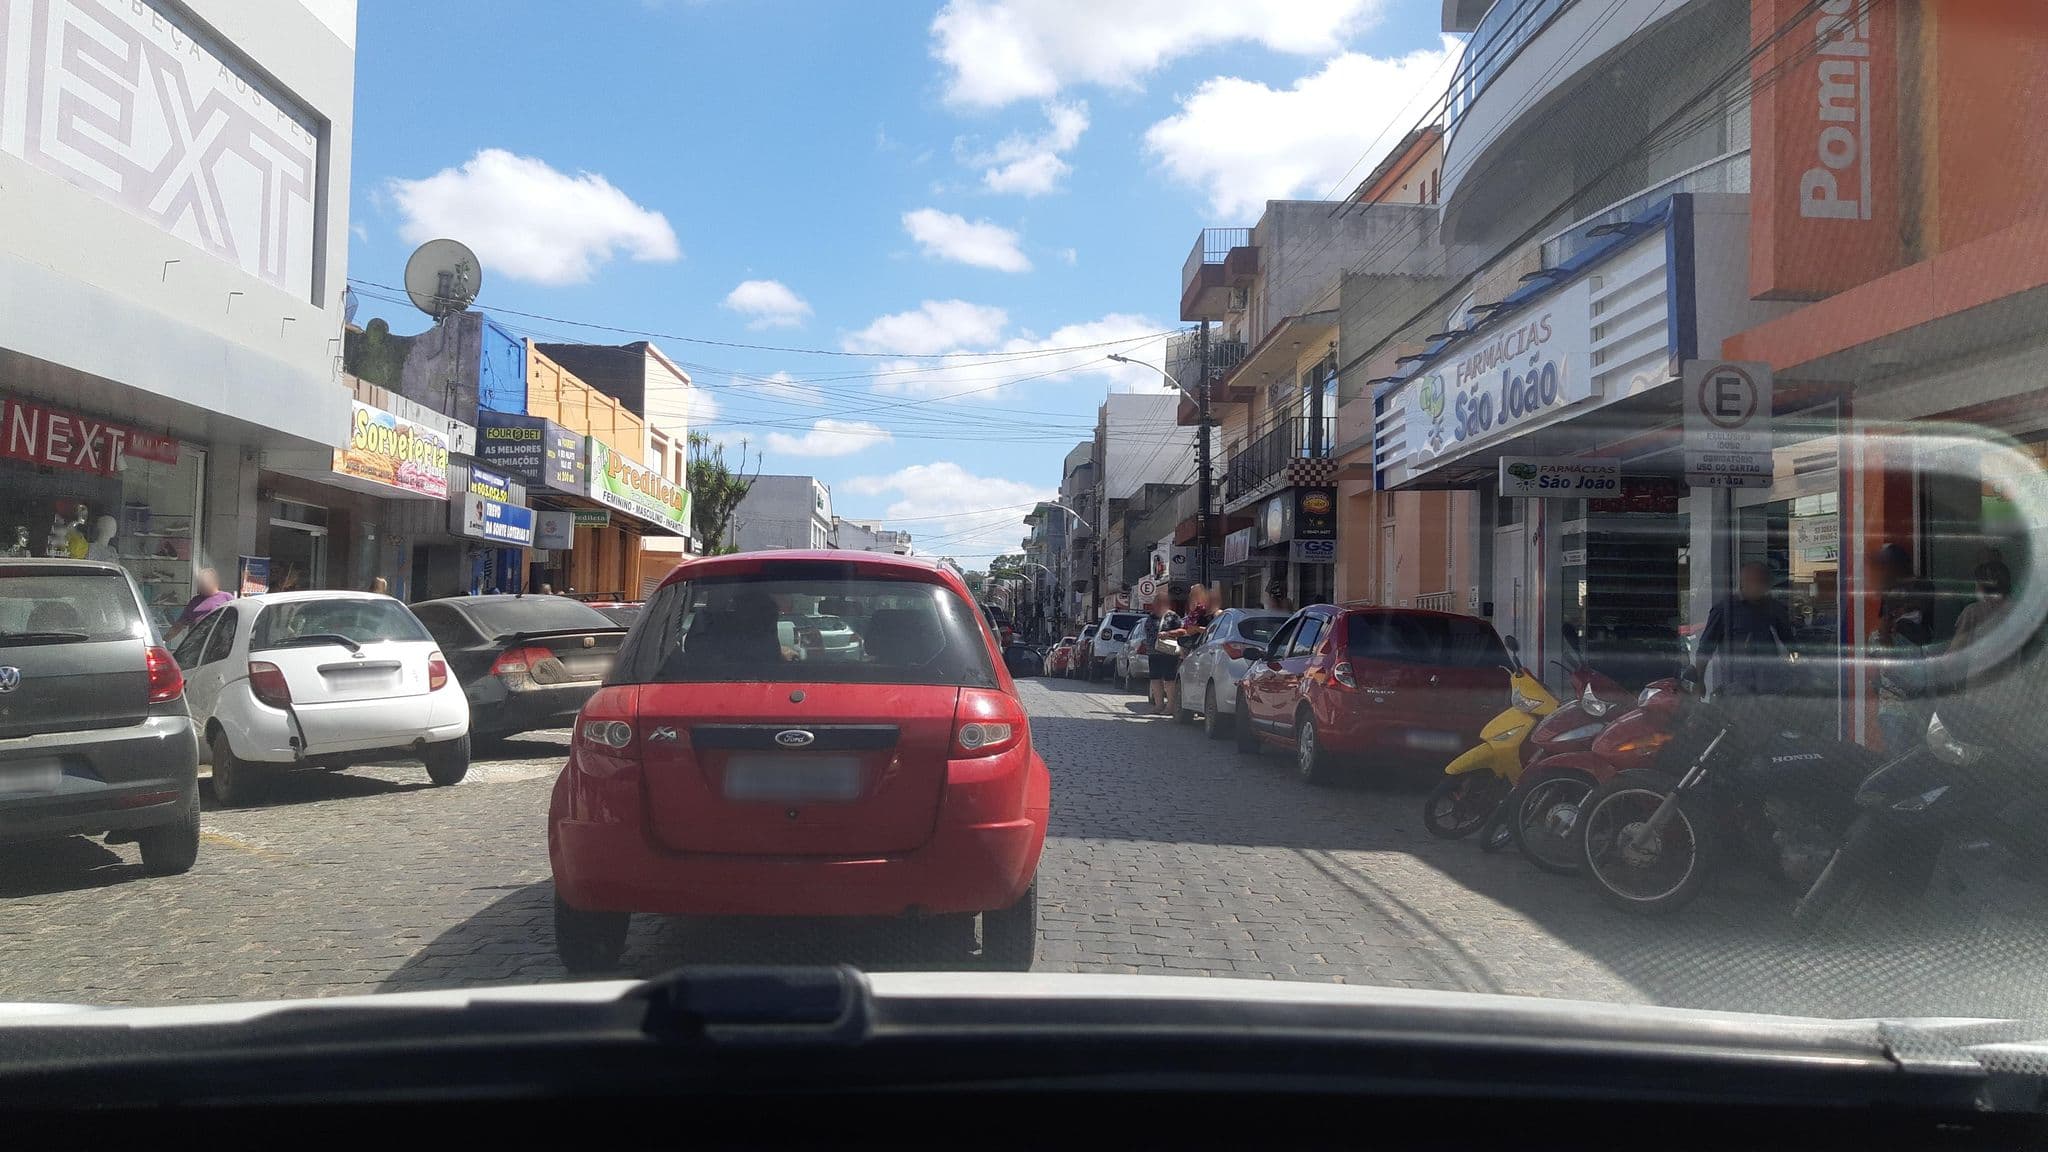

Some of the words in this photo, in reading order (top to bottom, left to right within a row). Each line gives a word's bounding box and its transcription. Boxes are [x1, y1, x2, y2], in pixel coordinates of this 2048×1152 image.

[1456, 313, 1552, 388] FARMÁCIAS
[1454, 381, 1494, 442] São
[1498, 350, 1558, 426] João
[1716, 376, 1741, 417] E
[10, 404, 126, 472] NEXT
[355, 408, 448, 469] Sorveteria
[487, 428, 511, 439] FOUR
[524, 429, 540, 440] BET
[485, 446, 496, 454] AS
[497, 445, 542, 454] MELHORES
[608, 449, 683, 511] Predileta
[1539, 463, 1617, 475] FARMÁCIAS
[1696, 463, 1713, 472] USO
[1539, 474, 1572, 490] São
[1575, 474, 1617, 490] João
[602, 490, 633, 511] FEMININO
[635, 505, 664, 525] MASCULINO
[1304, 540, 1334, 552] GS
[1771, 752, 1825, 763] HONDA
